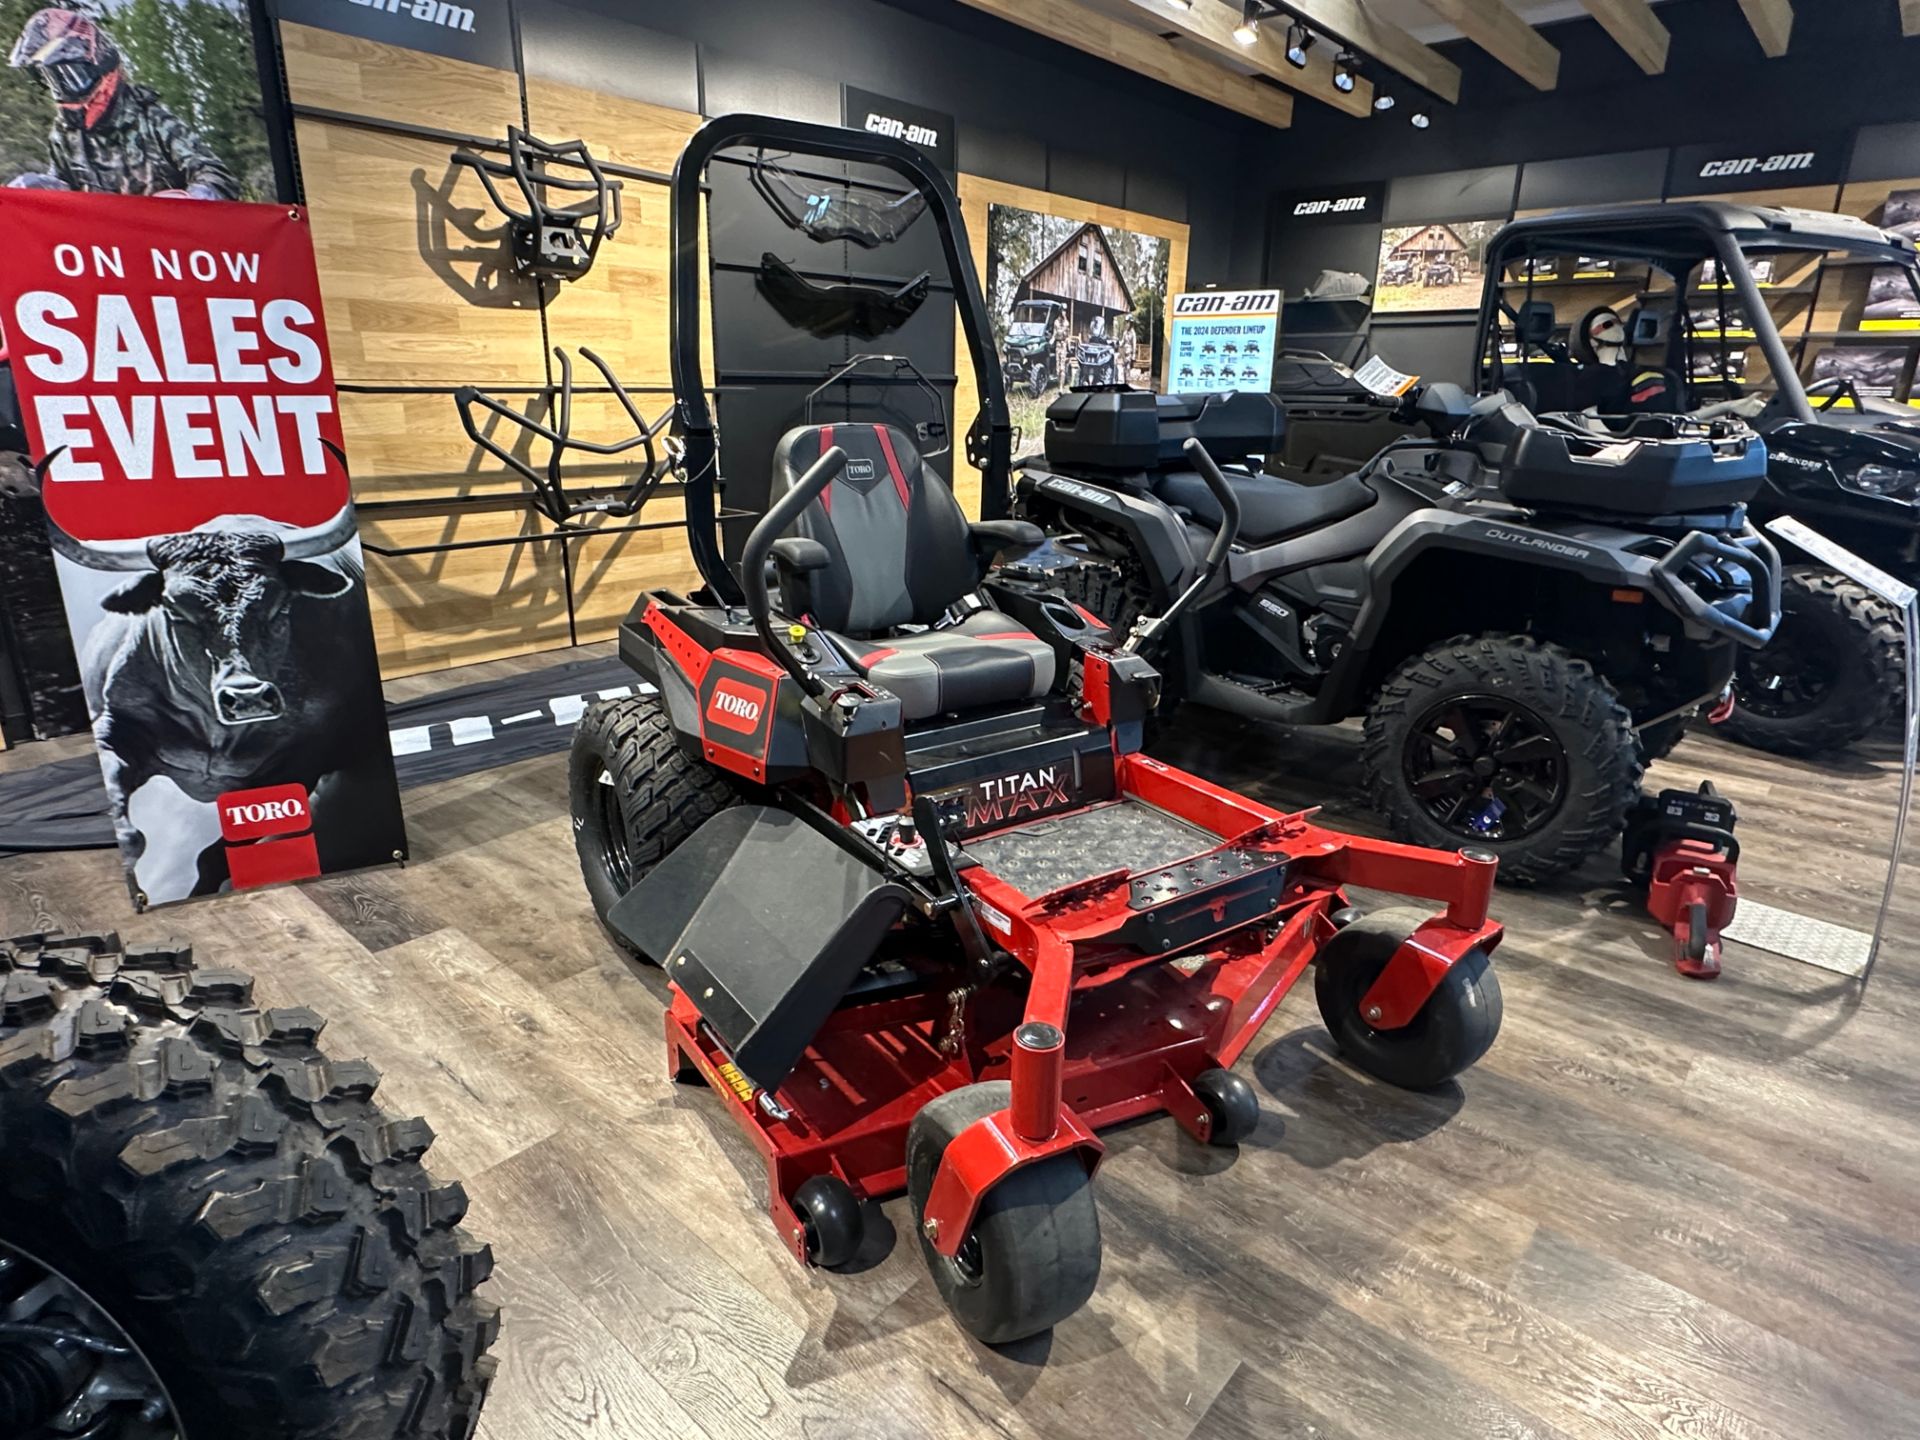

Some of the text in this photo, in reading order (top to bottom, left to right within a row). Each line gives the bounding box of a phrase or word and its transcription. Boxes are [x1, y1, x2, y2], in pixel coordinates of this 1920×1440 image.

[865, 113, 937, 147] can-am
[1700, 152, 1814, 177] can-am
[1293, 196, 1366, 215] can-am
[53, 243, 259, 283] ON NOW
[1176, 294, 1276, 312] can-am
[15, 290, 322, 384] SALES
[33, 395, 333, 482] EVENT
[1047, 478, 1112, 504] can-am
[1485, 529, 1590, 559] OUTLANDER
[715, 690, 759, 721] TORO
[979, 765, 1056, 801] TITAN
[225, 798, 305, 826] TORO
[966, 774, 1070, 828] MAX
